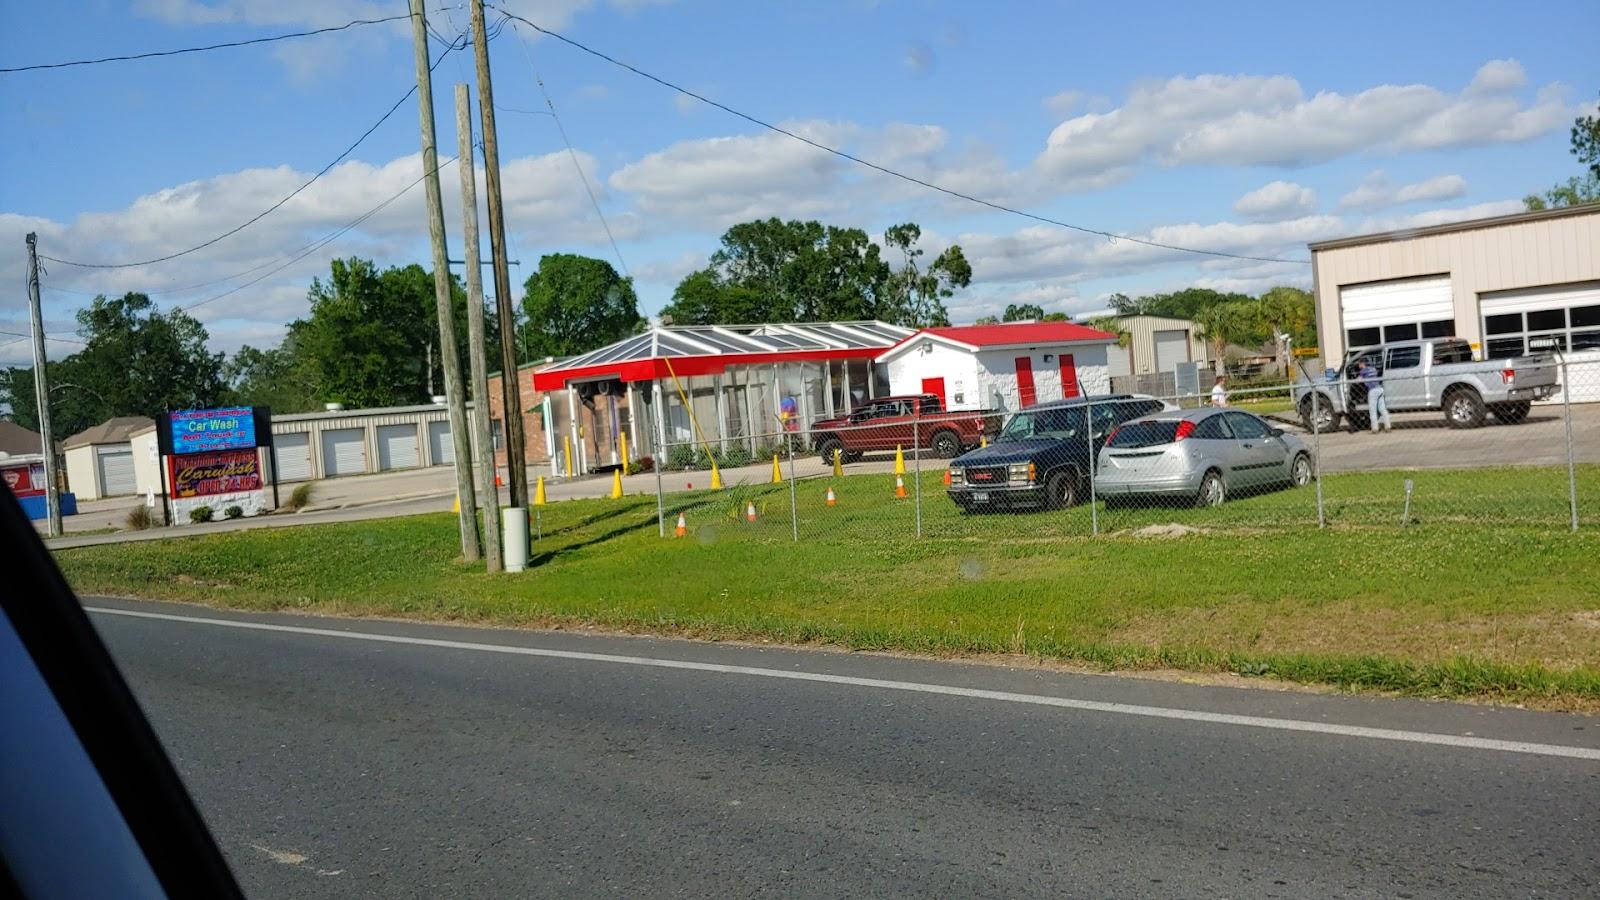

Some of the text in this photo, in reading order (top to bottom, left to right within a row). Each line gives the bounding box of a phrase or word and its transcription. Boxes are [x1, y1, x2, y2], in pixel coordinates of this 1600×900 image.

[188, 418, 239, 432] Car Wash
[177, 460, 255, 484] Carwash
